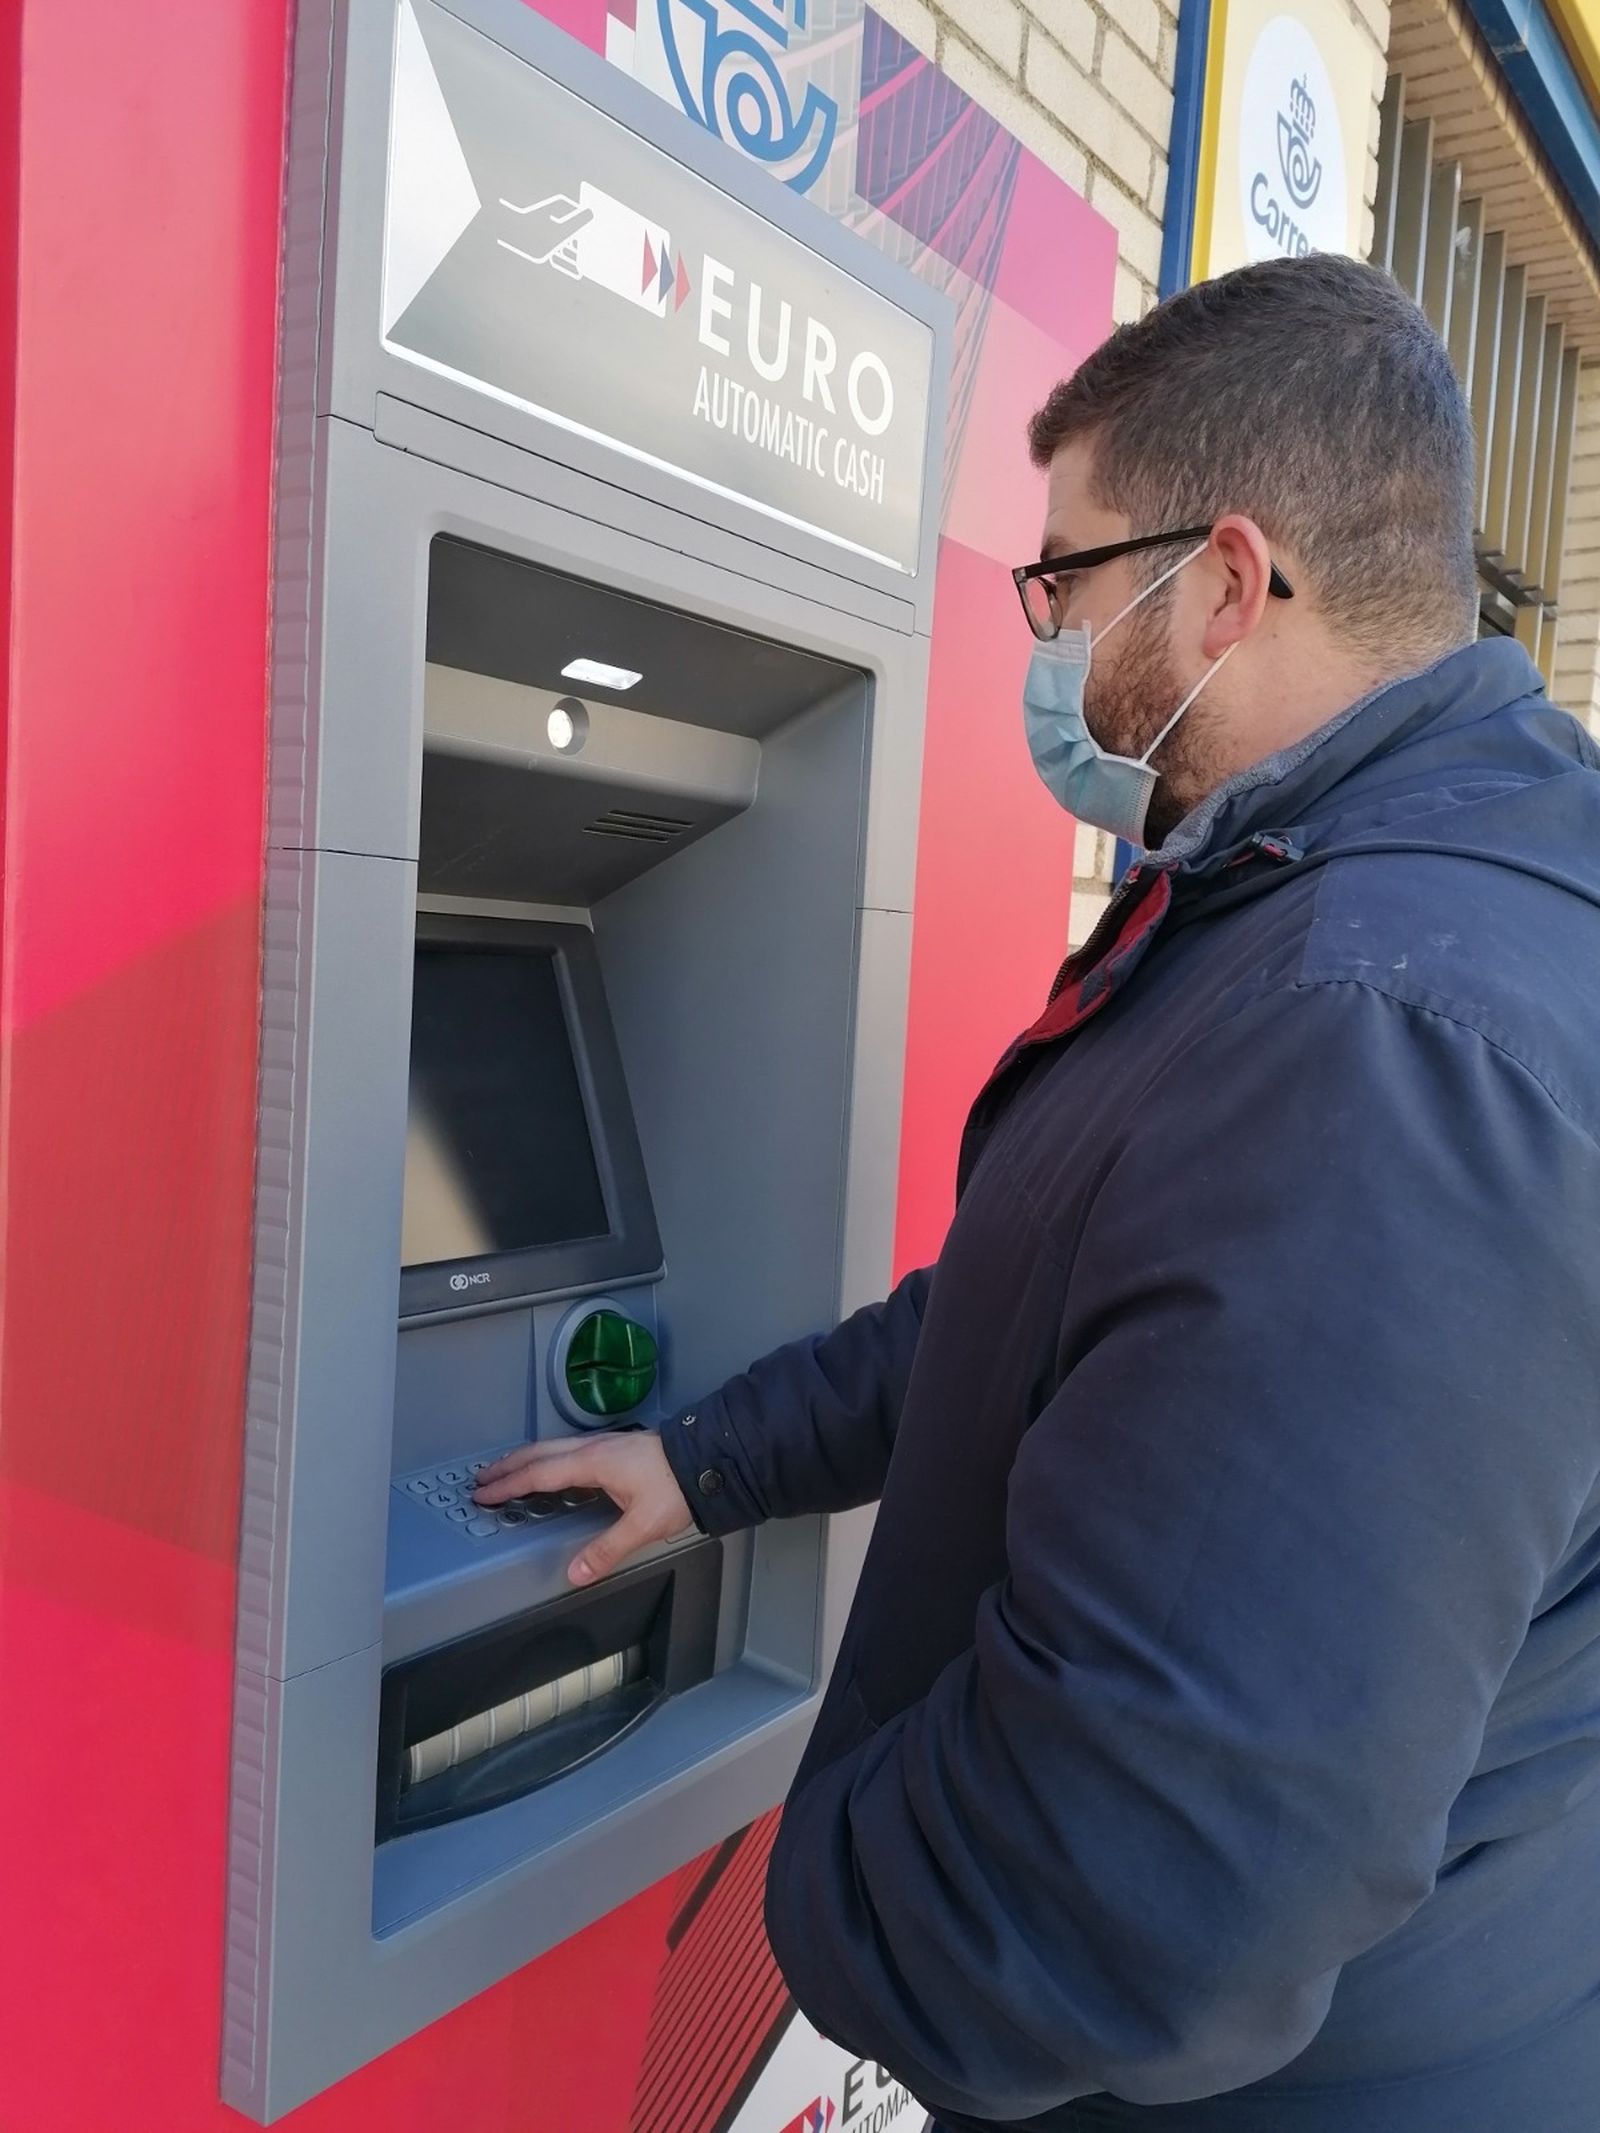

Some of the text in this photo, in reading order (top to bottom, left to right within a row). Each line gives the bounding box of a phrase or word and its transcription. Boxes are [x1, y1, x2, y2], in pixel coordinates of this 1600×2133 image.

[1251, 172, 1318, 257] Corre
[698, 254, 894, 436] EURO
[693, 365, 885, 504] AUTOMATIC CASH
[469, 1272, 490, 1285] NCR
